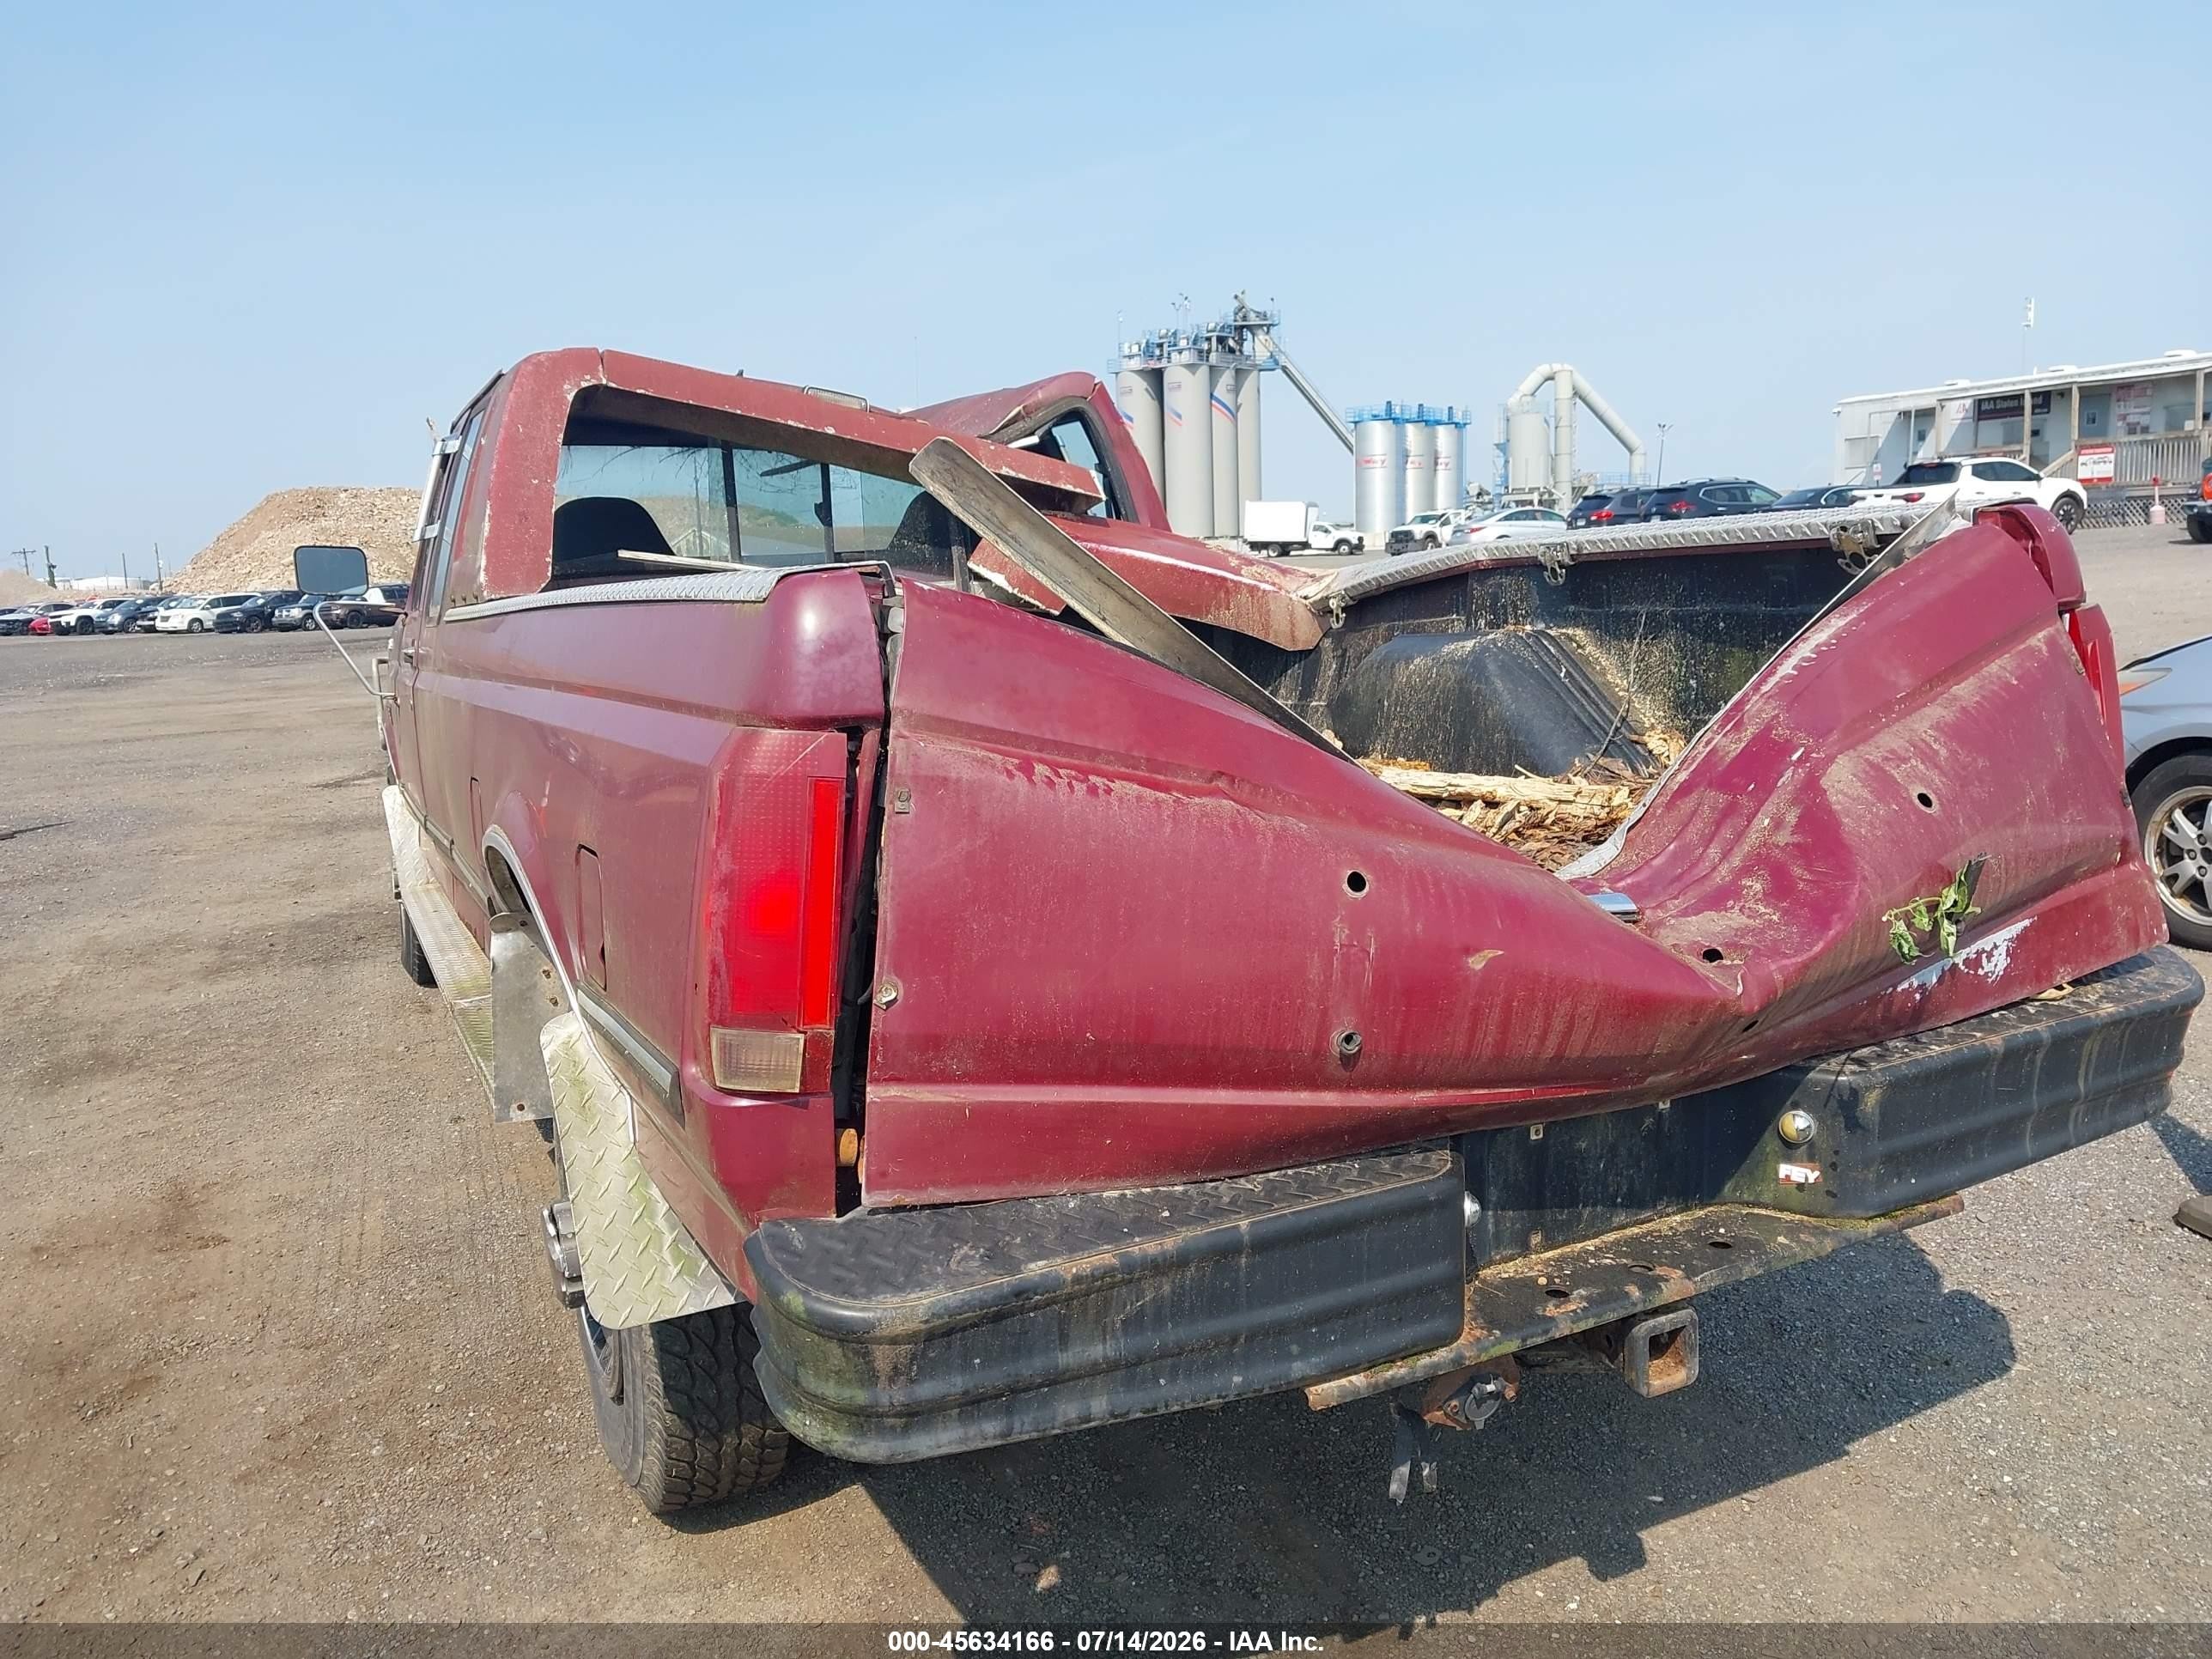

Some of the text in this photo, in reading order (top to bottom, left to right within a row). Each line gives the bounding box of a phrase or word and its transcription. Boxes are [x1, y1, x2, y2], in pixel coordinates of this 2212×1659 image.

[1981, 400, 1994, 410] IAA
[2021, 395, 2043, 406] Ind
[1779, 1164, 1821, 1183] FEY
